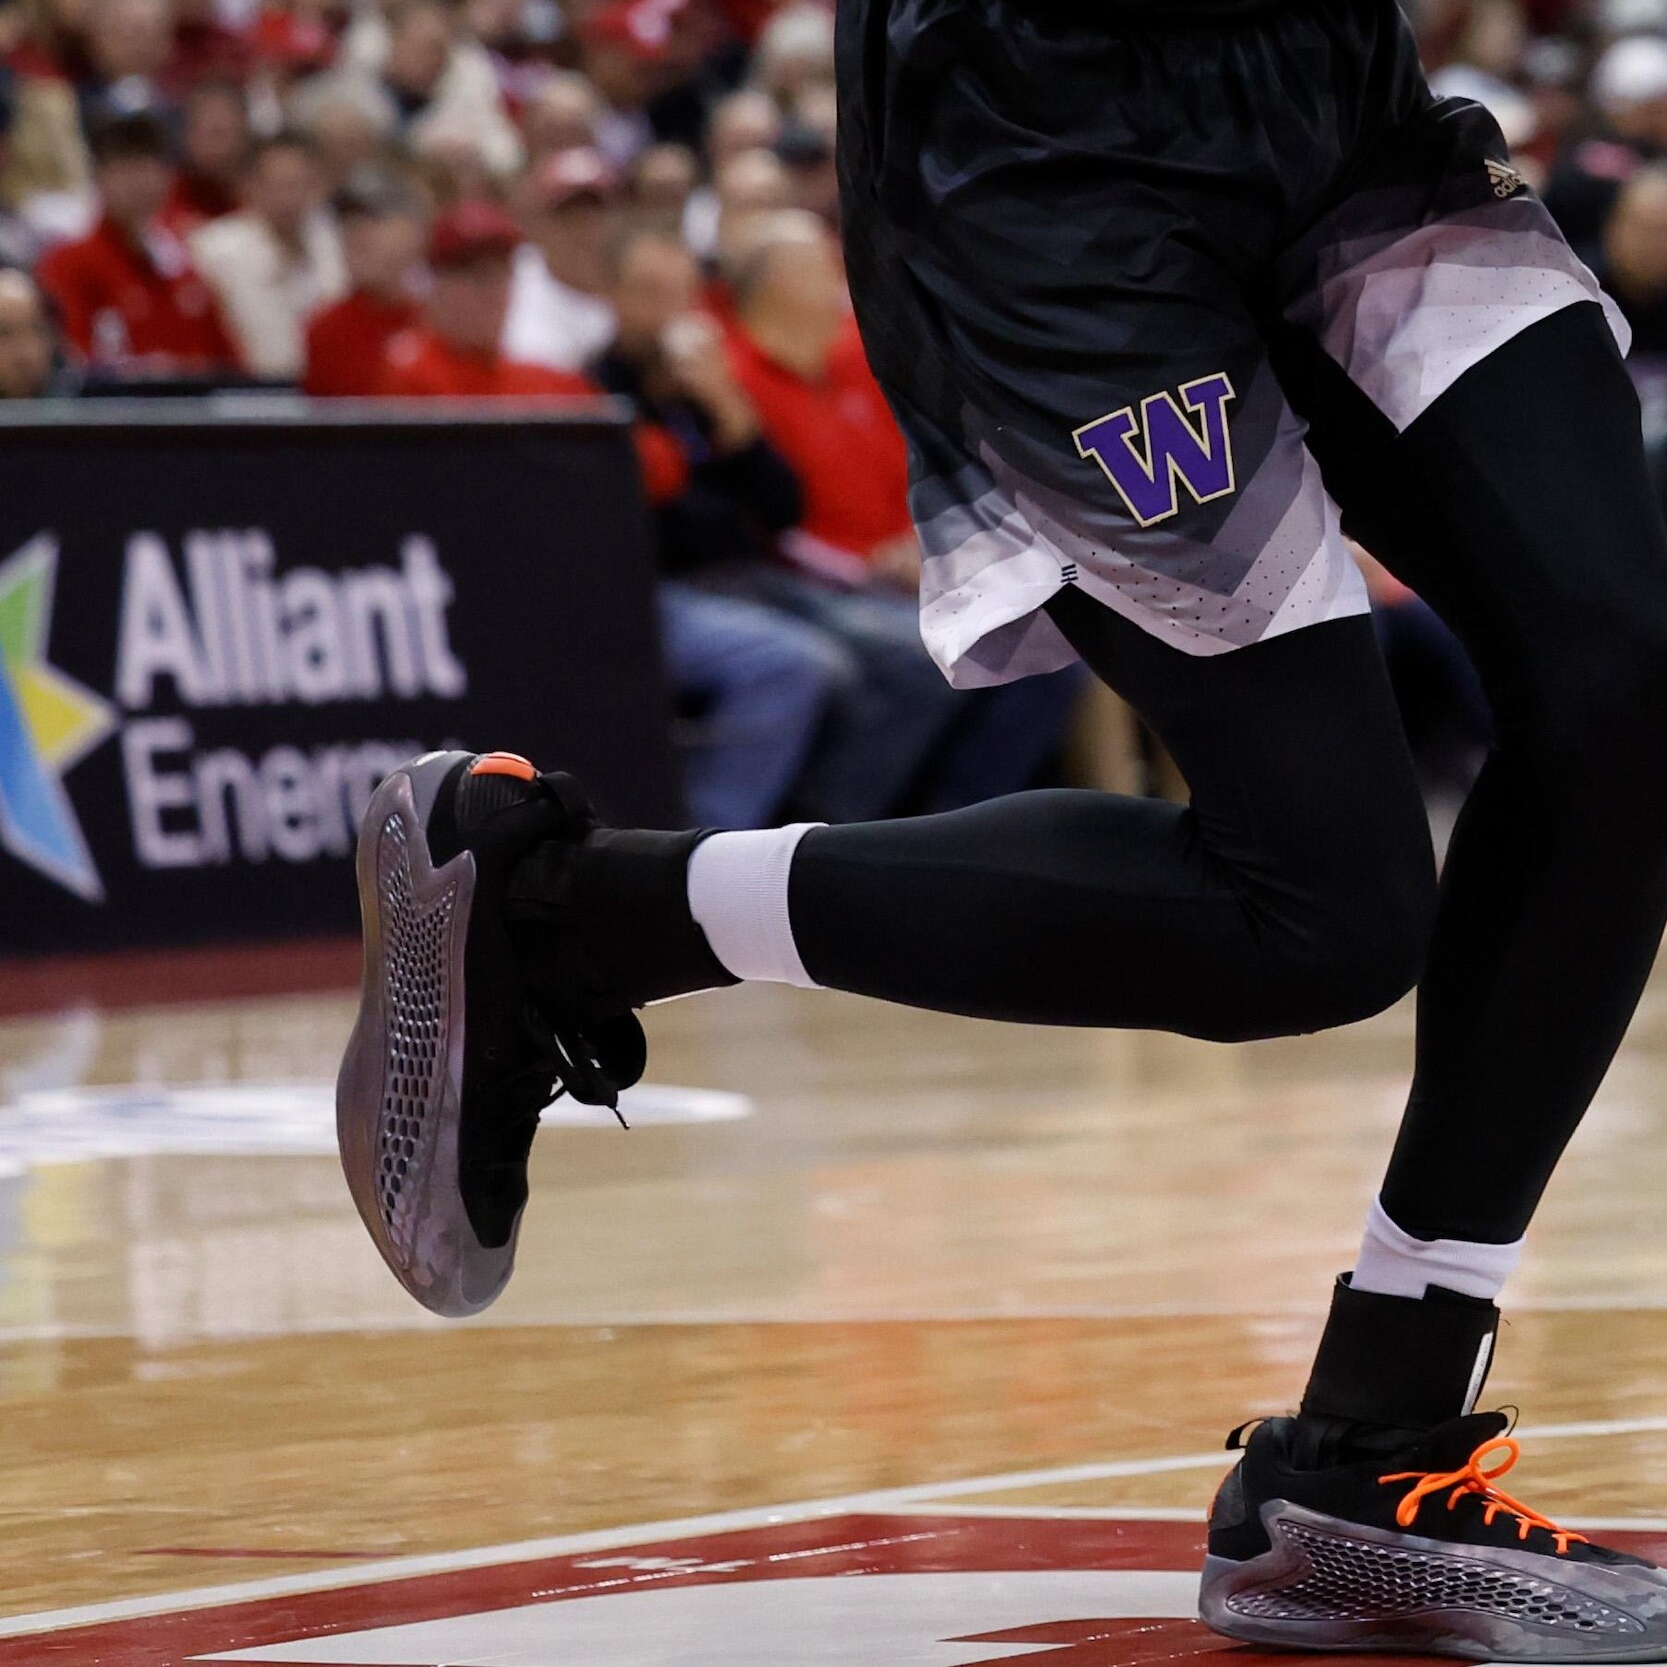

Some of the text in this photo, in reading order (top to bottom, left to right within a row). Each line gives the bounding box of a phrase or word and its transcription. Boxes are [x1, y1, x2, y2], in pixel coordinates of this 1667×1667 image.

[1072, 371, 1236, 528] W
[115, 530, 468, 708] Alliant
[118, 716, 466, 870] Ener
